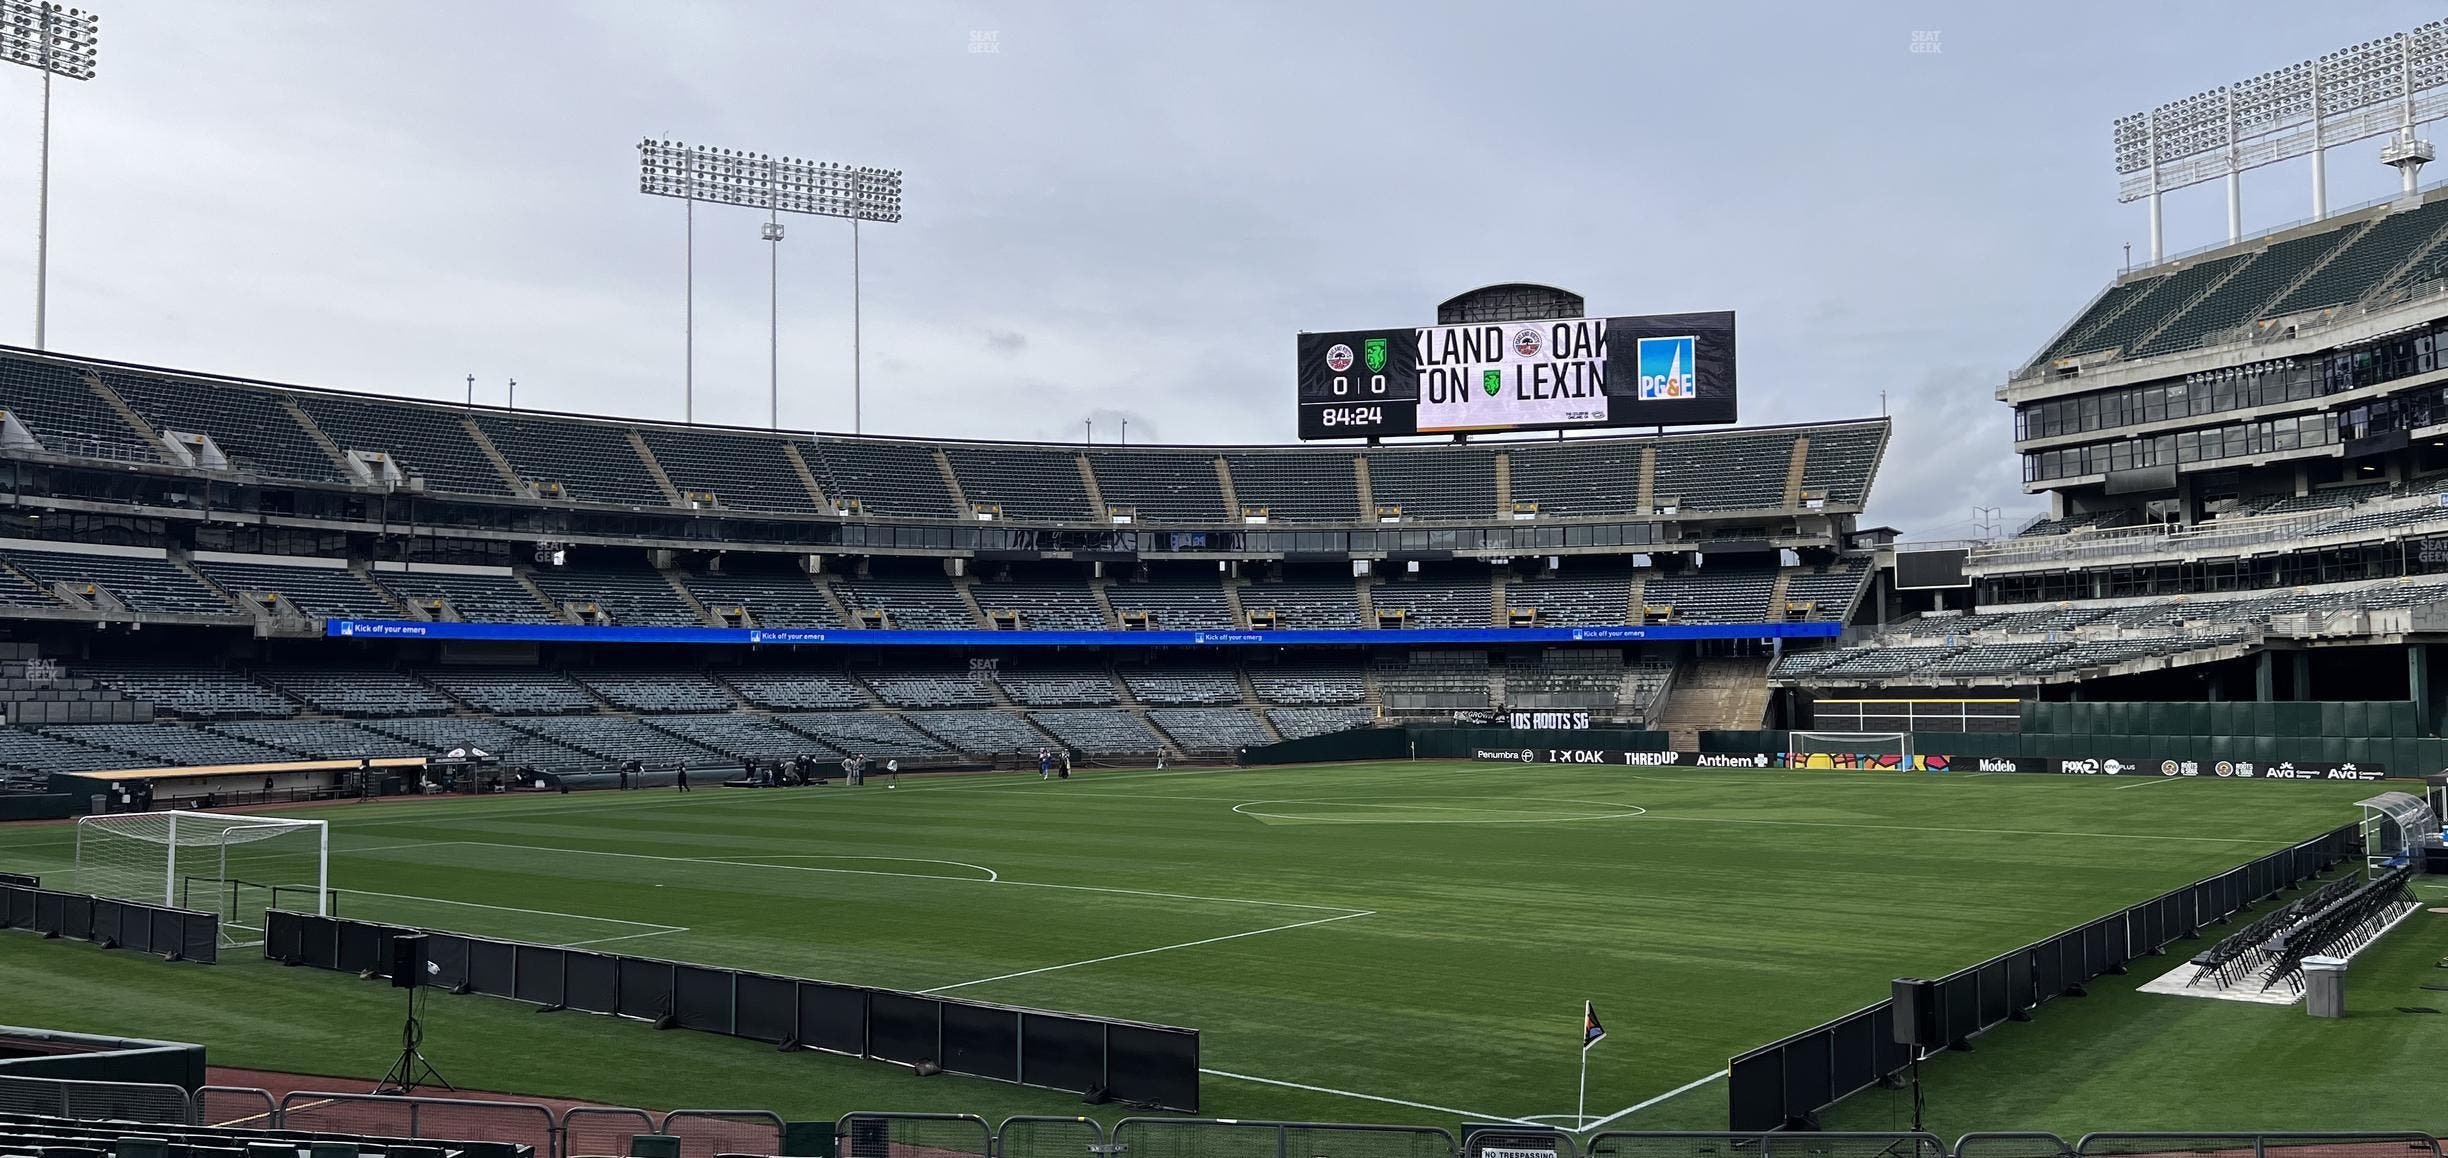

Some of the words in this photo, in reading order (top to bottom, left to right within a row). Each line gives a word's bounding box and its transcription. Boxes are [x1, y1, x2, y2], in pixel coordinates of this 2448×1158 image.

[1552, 321, 1607, 359] OAK
[1334, 376, 1347, 395] 0
[1371, 375, 1385, 393] 0
[1416, 367, 1468, 404] TON
[1517, 360, 1607, 400] LEXIN
[1642, 374, 1692, 397] PG&E
[1323, 407, 1382, 426] 84:24
[1510, 712, 1530, 729] LOS
[1533, 712, 1571, 729] ROOTS
[1478, 750, 1519, 759] Penumbra
[1575, 750, 1604, 763] OAK
[1625, 751, 1679, 765] THREDUP
[1697, 754, 1751, 767] Anthem
[1980, 759, 2016, 772] Modelo
[2266, 768, 2294, 778] Ava
[2328, 769, 2356, 779] Ava
